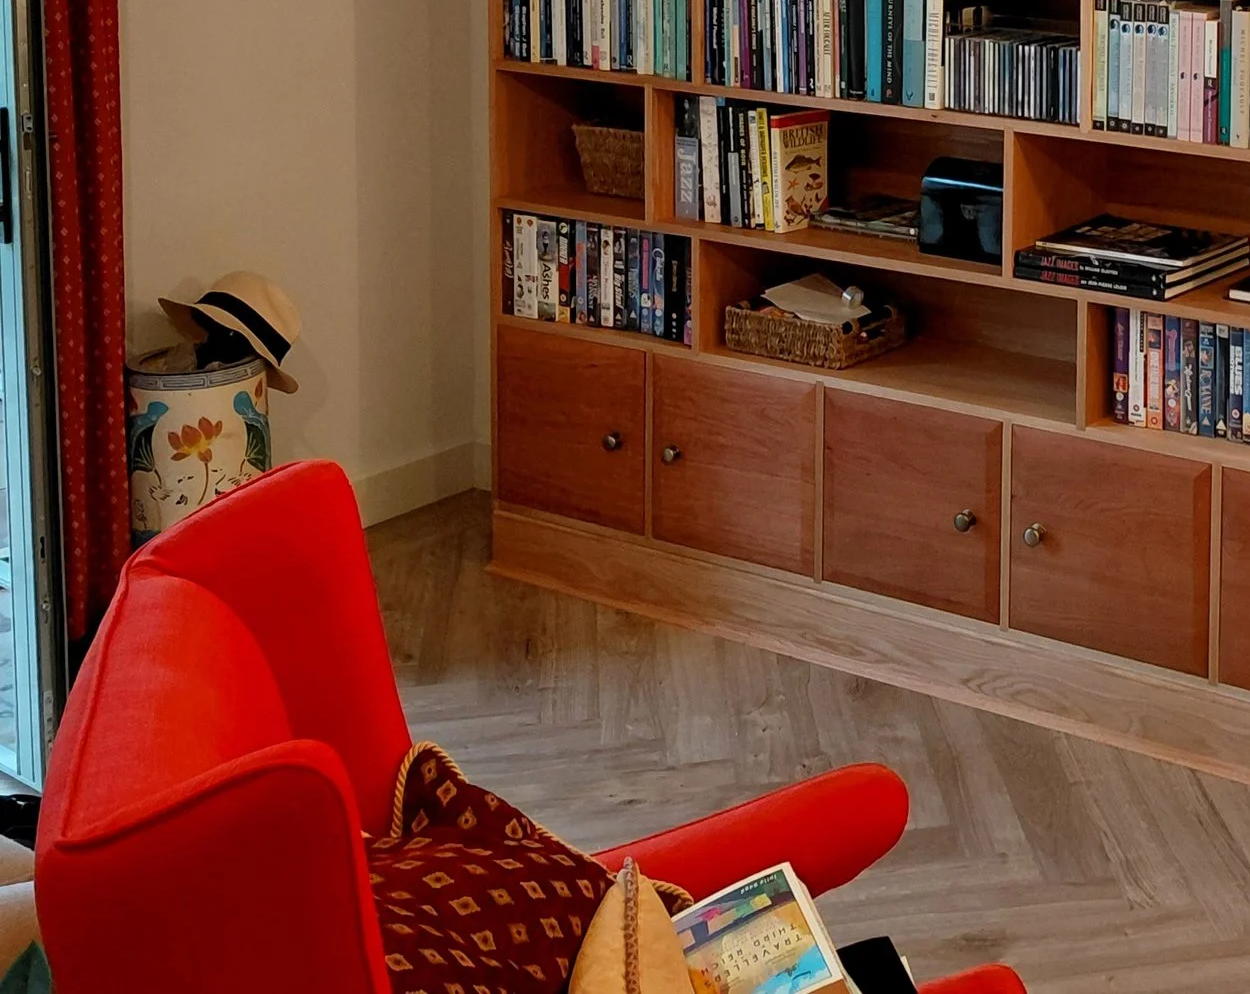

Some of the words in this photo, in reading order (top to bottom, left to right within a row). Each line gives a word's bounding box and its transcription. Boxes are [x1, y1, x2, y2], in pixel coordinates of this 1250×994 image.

[782, 125, 823, 136] BRITISH
[677, 148, 696, 203] Jazz
[614, 273, 622, 286] Big
[1056, 259, 1078, 271] IMAGES
[542, 263, 551, 300] Ashes
[1234, 346, 1242, 395] BLUES
[754, 923, 796, 947] THIRD
[701, 948, 743, 977] REICH
[704, 936, 802, 986] TRAVELLERS
